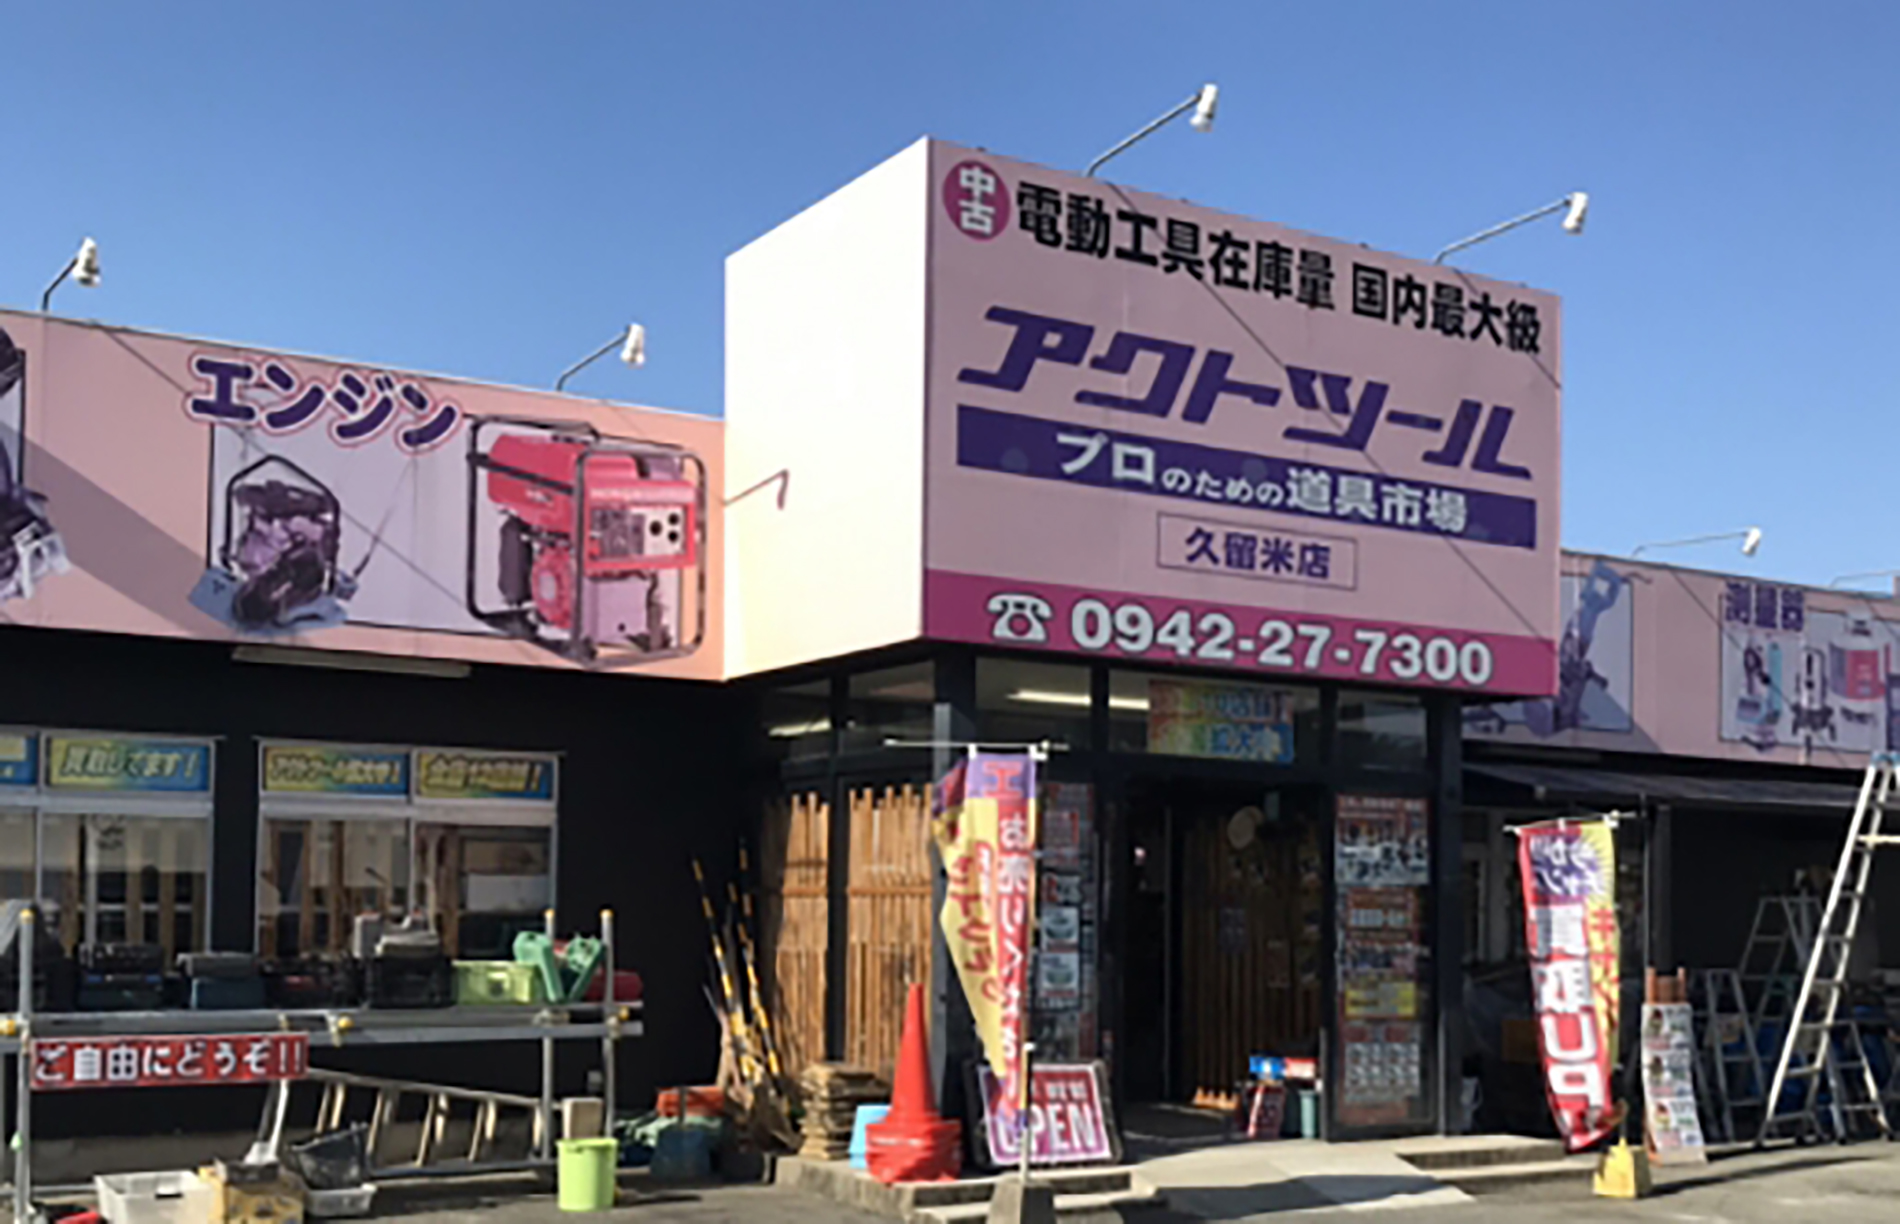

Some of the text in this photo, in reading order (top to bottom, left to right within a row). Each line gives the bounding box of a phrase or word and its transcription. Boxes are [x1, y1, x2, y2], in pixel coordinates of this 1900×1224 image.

[958, 165, 995, 236] 中古
[1016, 181, 1542, 355] 電動工具在庫量 国内最大級
[190, 356, 460, 449] エンジン
[957, 304, 1533, 480] アクトツール
[1055, 431, 1468, 534] プロのための道具市場
[1184, 526, 1332, 579] 久留米店
[1070, 598, 1493, 686] 0942-27-7300
[35, 1037, 302, 1081] ご自由にどうぞ!!
